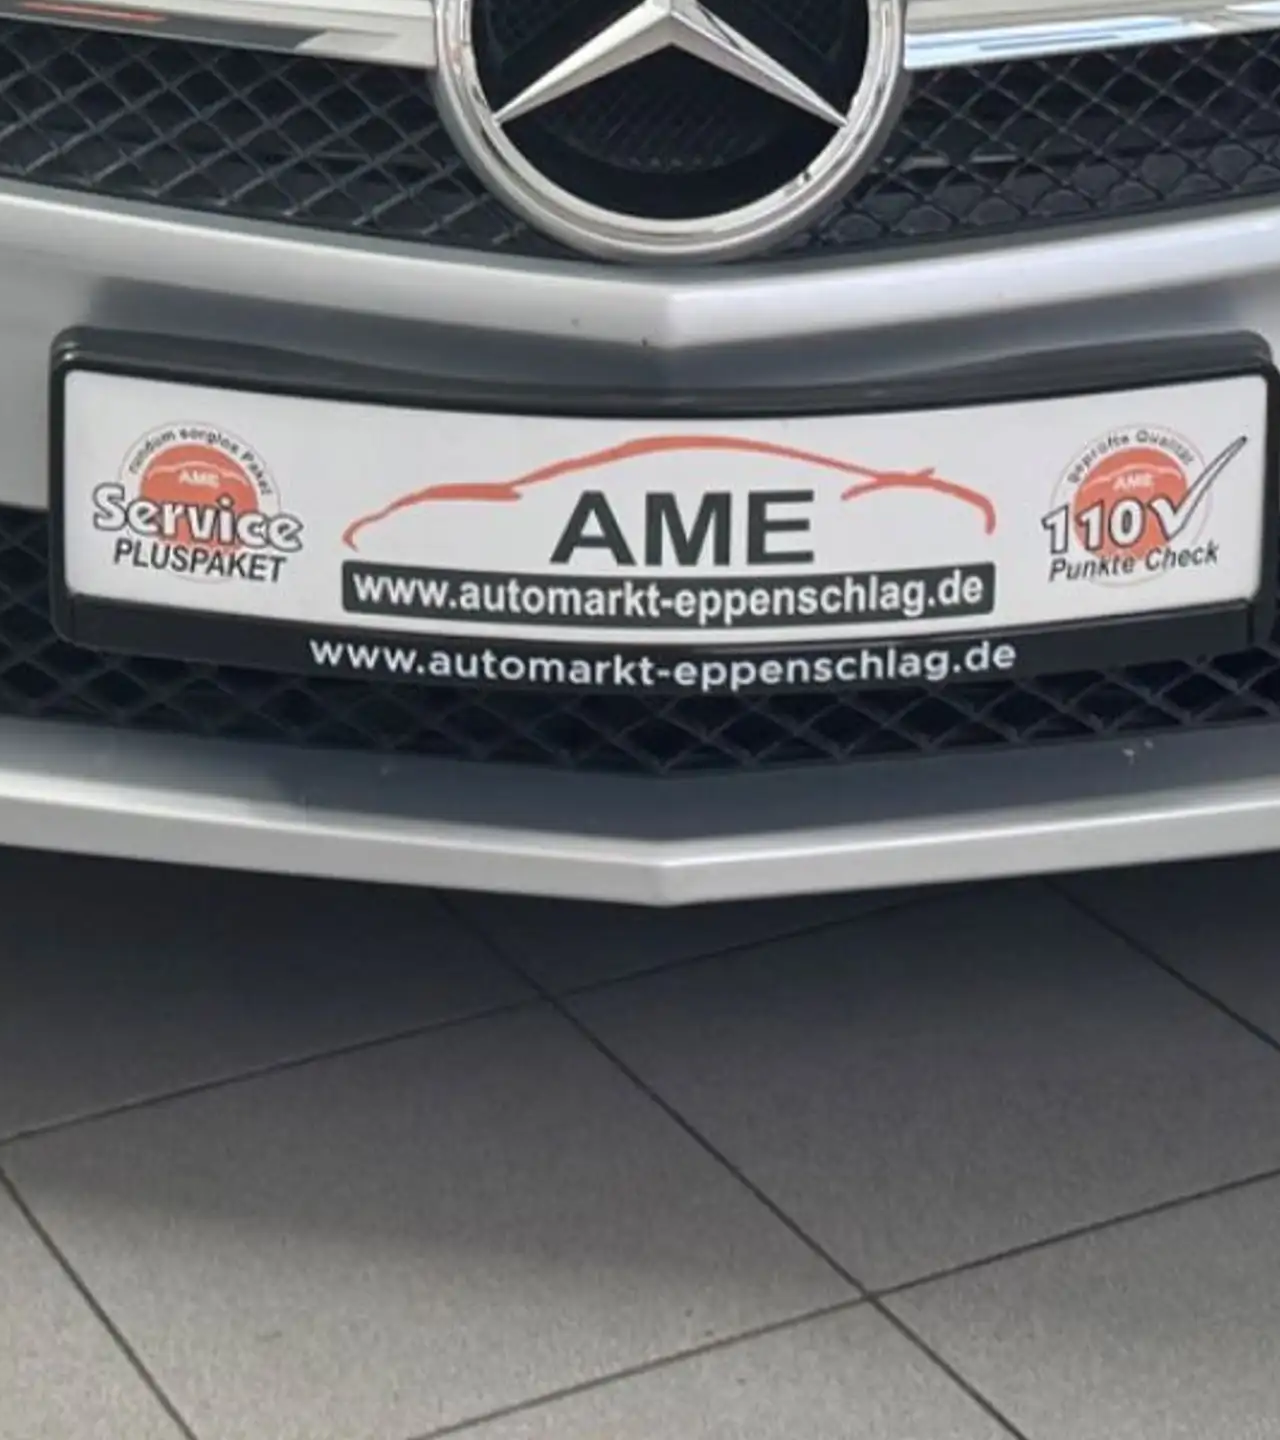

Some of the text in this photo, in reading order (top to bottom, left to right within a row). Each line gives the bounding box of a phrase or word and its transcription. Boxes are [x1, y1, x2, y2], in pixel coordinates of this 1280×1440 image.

[93, 482, 304, 553] Service
[550, 489, 815, 567] AME
[114, 538, 288, 583] PLUSPAKET
[1048, 539, 1220, 582] Punkte Check
[352, 571, 985, 625] www.automarkt-eppenschlag.de
[310, 639, 1017, 693] www.automarkt-eppenschlag.de
